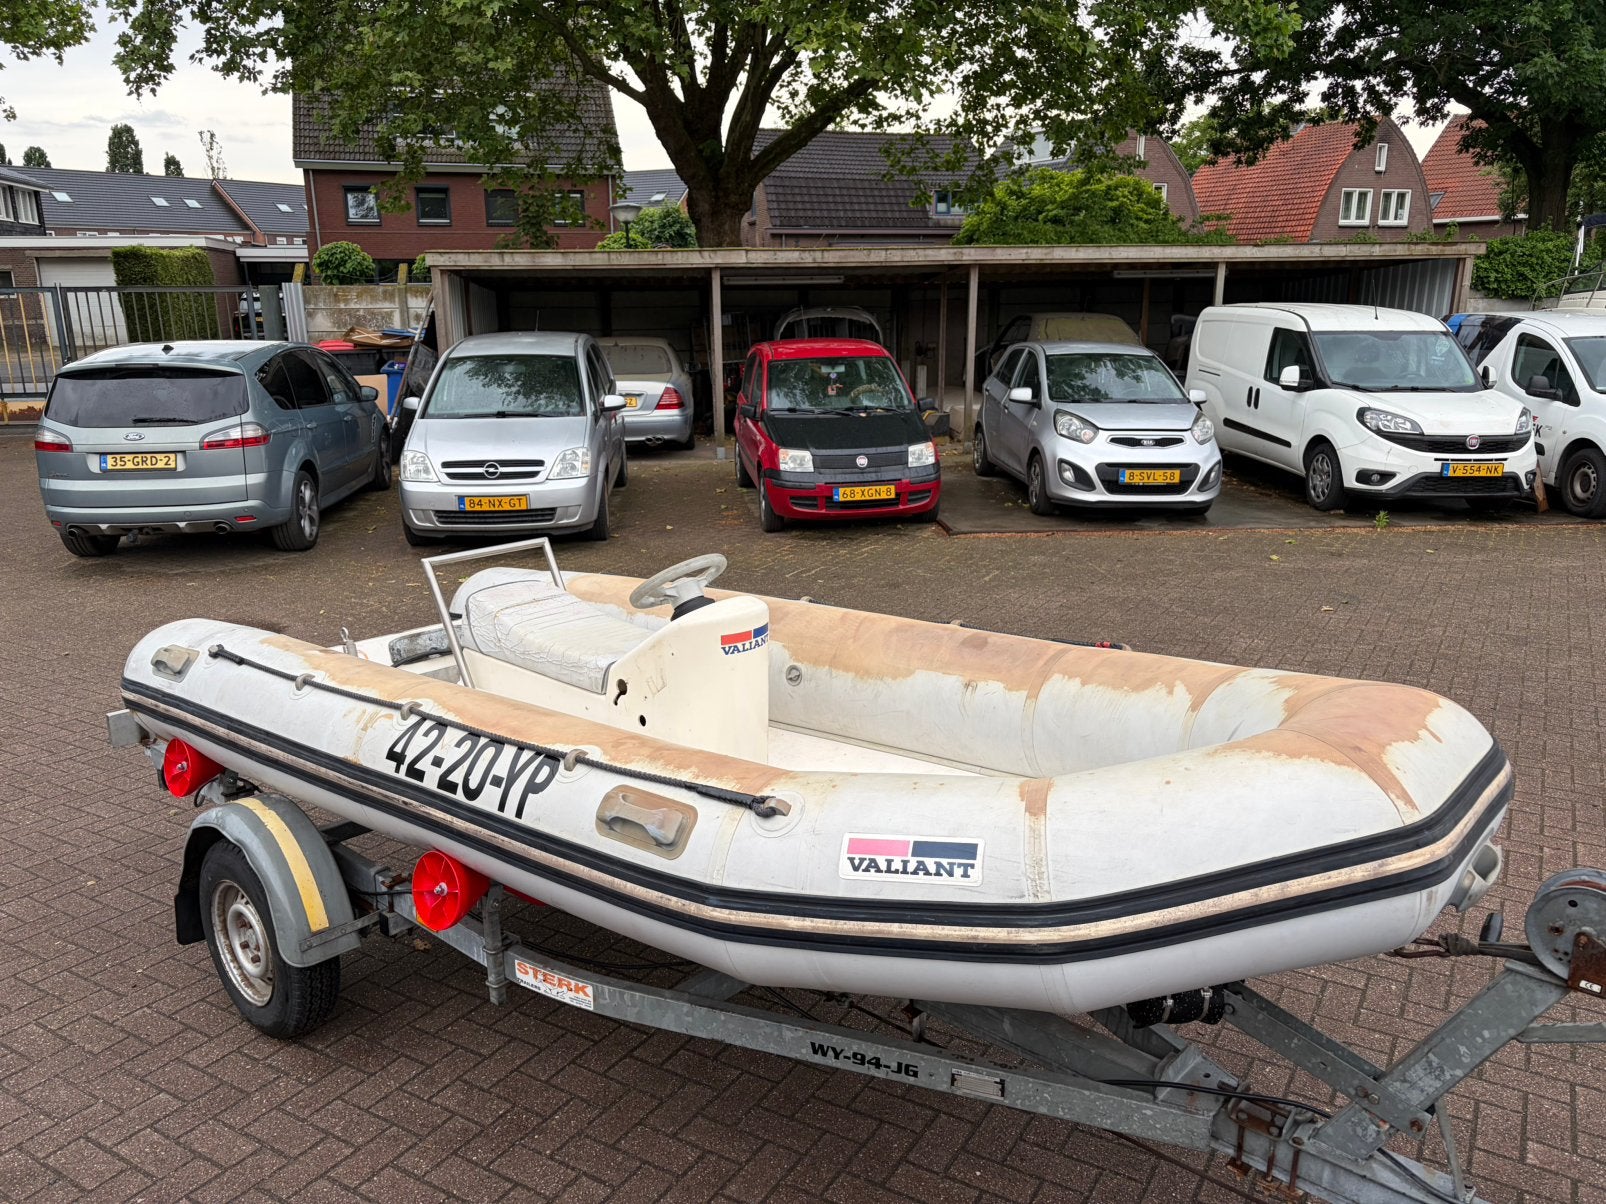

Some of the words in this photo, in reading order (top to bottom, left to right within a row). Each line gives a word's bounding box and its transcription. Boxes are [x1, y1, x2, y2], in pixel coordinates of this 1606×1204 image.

[111, 455, 172, 467] 35-GRD-2
[1128, 471, 1176, 481] 8-SVL-58
[1452, 465, 1500, 475] V-554-NK
[842, 487, 892, 499] 68-XGN-8
[468, 498, 523, 509] 84-NX-GT
[385, 717, 561, 820] 42-20-YP
[847, 856, 976, 879] VALIANT
[516, 961, 592, 998] STERK
[810, 1041, 920, 1079] WY-94-JG
